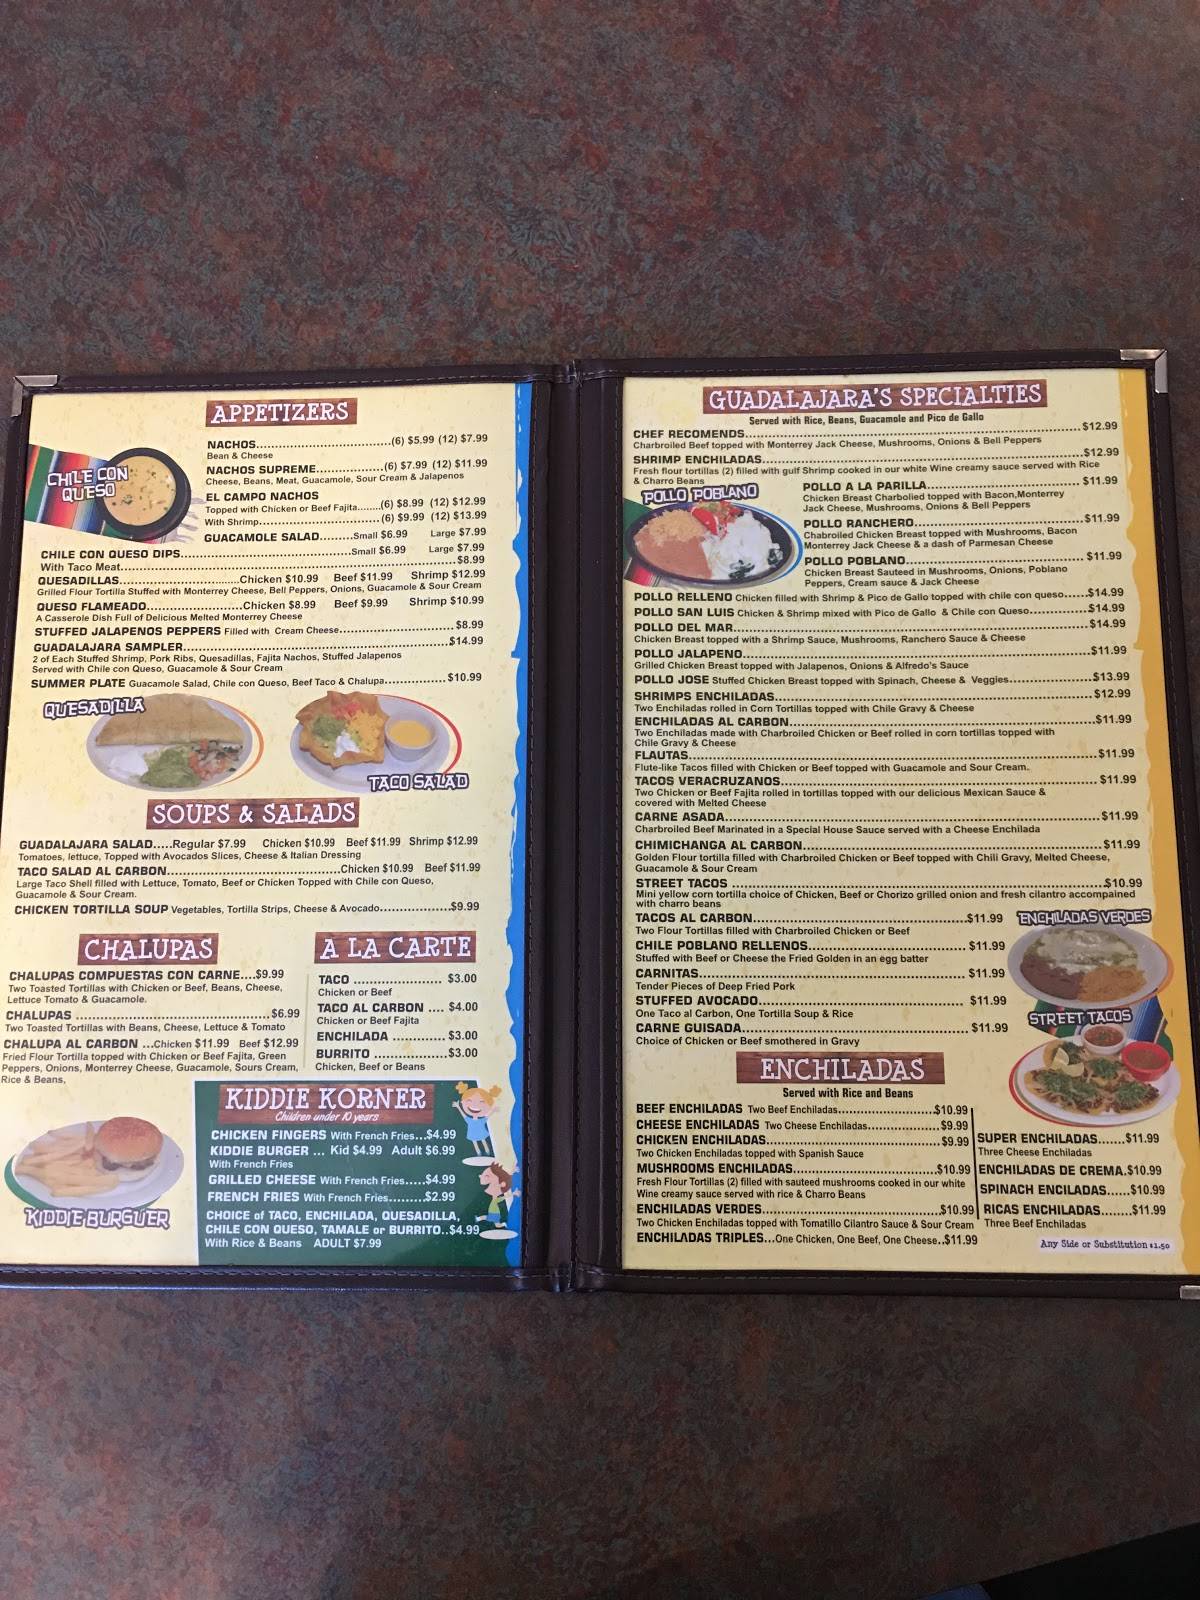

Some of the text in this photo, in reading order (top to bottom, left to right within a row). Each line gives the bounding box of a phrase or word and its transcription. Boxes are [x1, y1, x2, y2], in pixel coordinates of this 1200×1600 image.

[709, 384, 1042, 411] GUADALAJARA'S SPECIALTIES
[211, 402, 349, 425] APPETIZERS
[749, 416, 779, 425] Served
[782, 416, 801, 424] with
[859, 414, 907, 423] Guacamole
[909, 413, 925, 422] and
[927, 413, 946, 422] Pico
[949, 412, 960, 421] de
[962, 412, 984, 421] Gallo
[408, 433, 488, 445] $5.99 (12) $7.99
[240, 451, 274, 459] Cheese
[47, 466, 128, 487] CHILE CON
[356, 474, 377, 482] Sour
[419, 472, 465, 481] Jalapenos
[1082, 475, 1118, 486] $11.99
[62, 483, 115, 502] QUESO
[206, 491, 319, 501] EL CAMPO NACHOS
[643, 484, 757, 504] POLLO POBLANO
[430, 527, 487, 538] Large $7.99
[1086, 551, 1122, 561] $11.99
[411, 569, 486, 580] Shrimp $12.99
[634, 592, 732, 601] POLLO RELLENO
[634, 607, 735, 617] POLLO SAN LUIS
[35, 626, 221, 636] STUFFED JALAPENOS PEPPERS
[31, 678, 126, 688] SUMMER PLATE
[634, 674, 709, 684] POLLO JOSE
[44, 698, 145, 719] QUESADILLA
[368, 774, 468, 791] TACO SALAD
[634, 798, 767, 807] covered with Melted Cheese
[152, 802, 356, 824] SOUPS & SALADS
[217, 835, 478, 848] $7.99 Chicken $10.99 Beef $11.99 Shrimp $12.99
[636, 878, 728, 888] STREET TACOS
[14, 904, 169, 914] CHICKEN TORTILLA SOUP
[1017, 910, 1151, 925] ENCHILADAS VERDES
[84, 937, 213, 960] CHALUPAS
[319, 936, 472, 959] A LA CARTE
[969, 940, 1006, 951] $11.99
[318, 973, 477, 984] TACO $3.00
[318, 988, 356, 996] Chicken
[370, 987, 393, 996] Beef
[635, 981, 795, 992] Tender Pieces of Deep Fried Pork
[317, 1001, 478, 1012] TACO AL CARBON $4.00
[1028, 1009, 1132, 1025] STREET TACOS
[636, 1036, 670, 1045] Choice
[672, 1036, 683, 1045] of
[685, 1036, 724, 1045] Chicken
[740, 1036, 762, 1045] Beef
[764, 1036, 817, 1045] smothered
[819, 1036, 828, 1045] in
[831, 1036, 860, 1047] Gravy
[760, 1058, 925, 1081] ENCHILADAS
[225, 1087, 426, 1110] KIDDIE KORNER
[636, 1103, 743, 1113] BEEF ENCHILADAS
[275, 1112, 380, 1124] Children under 10 years
[636, 1119, 760, 1130] CHEESE ENCHILADAS
[211, 1129, 326, 1140] CHICKEN FINGERS
[330, 1144, 455, 1156] Kid $4.99 Adult $6.99
[978, 1146, 1092, 1157] Three Cheese Enchiladas
[208, 1174, 316, 1184] GRILLED CHEESE
[26, 1210, 168, 1228] KIDDIE BURGUER
[206, 1210, 250, 1220] CHOICE
[254, 1210, 265, 1220] of
[984, 1218, 1087, 1229] Three Beef Enchiladas
[204, 1237, 382, 1248] With Rice & Beans ADULT $7.99
[1040, 1239, 1059, 1249] Any
[1061, 1239, 1079, 1248] Side
[1094, 1239, 1148, 1249] Substitution
